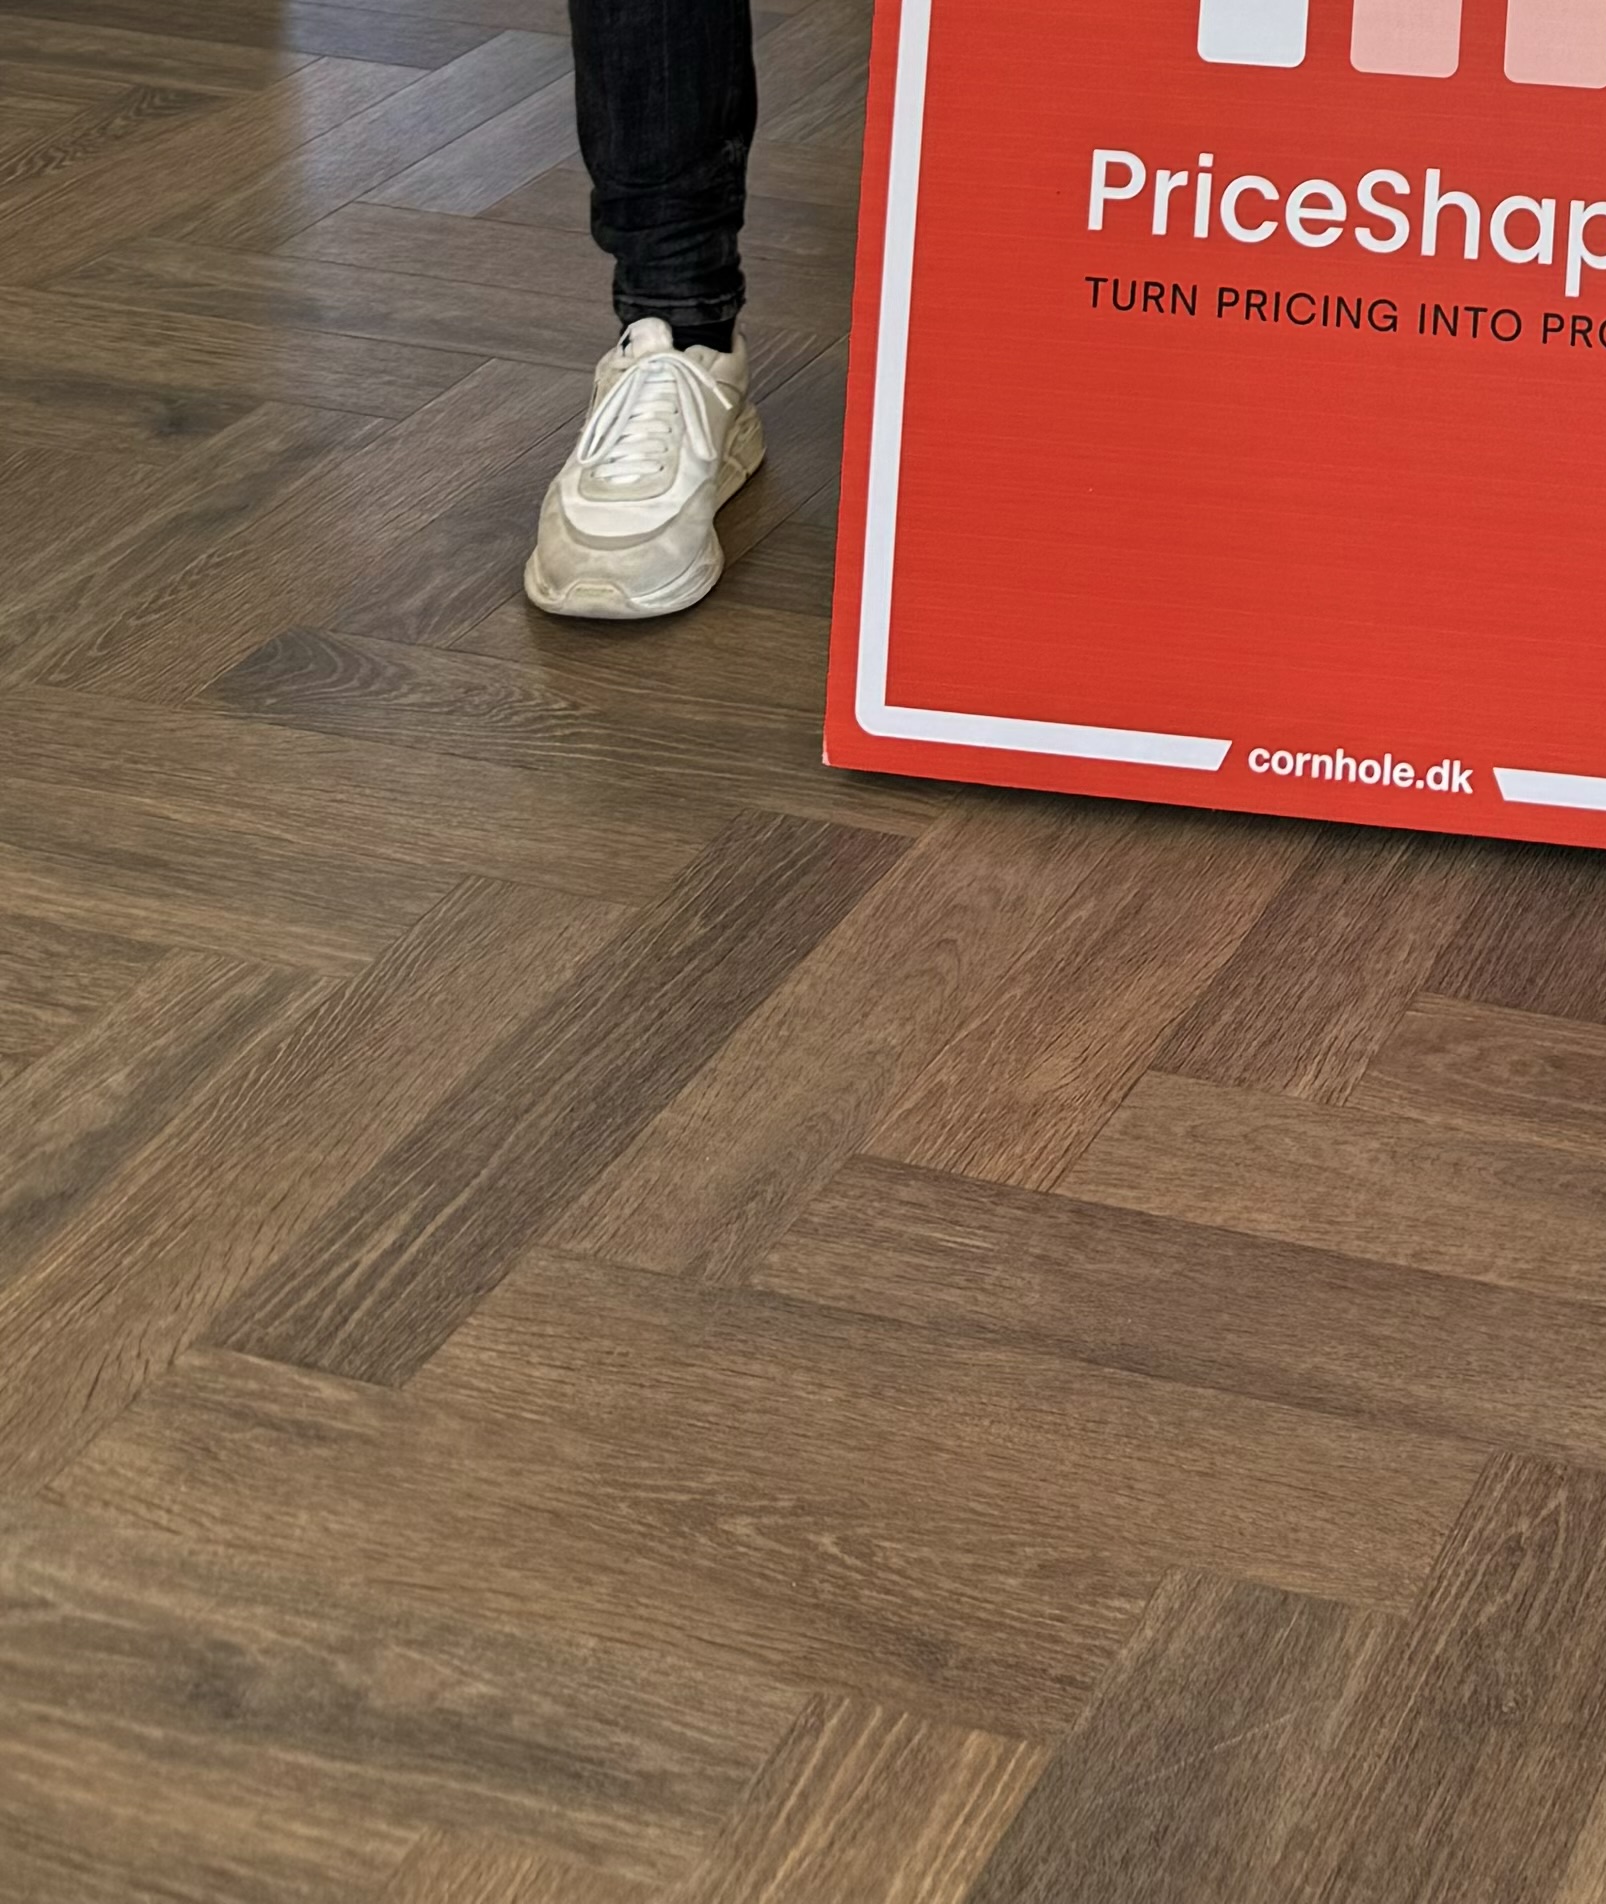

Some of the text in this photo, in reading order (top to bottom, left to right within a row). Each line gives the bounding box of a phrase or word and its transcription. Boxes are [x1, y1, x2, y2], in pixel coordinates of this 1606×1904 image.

[1085, 276, 1197, 316] TURN
[1217, 287, 1398, 332] PRICING
[1418, 303, 1523, 342] INTO
[1248, 747, 1474, 794] cornhole.dk
